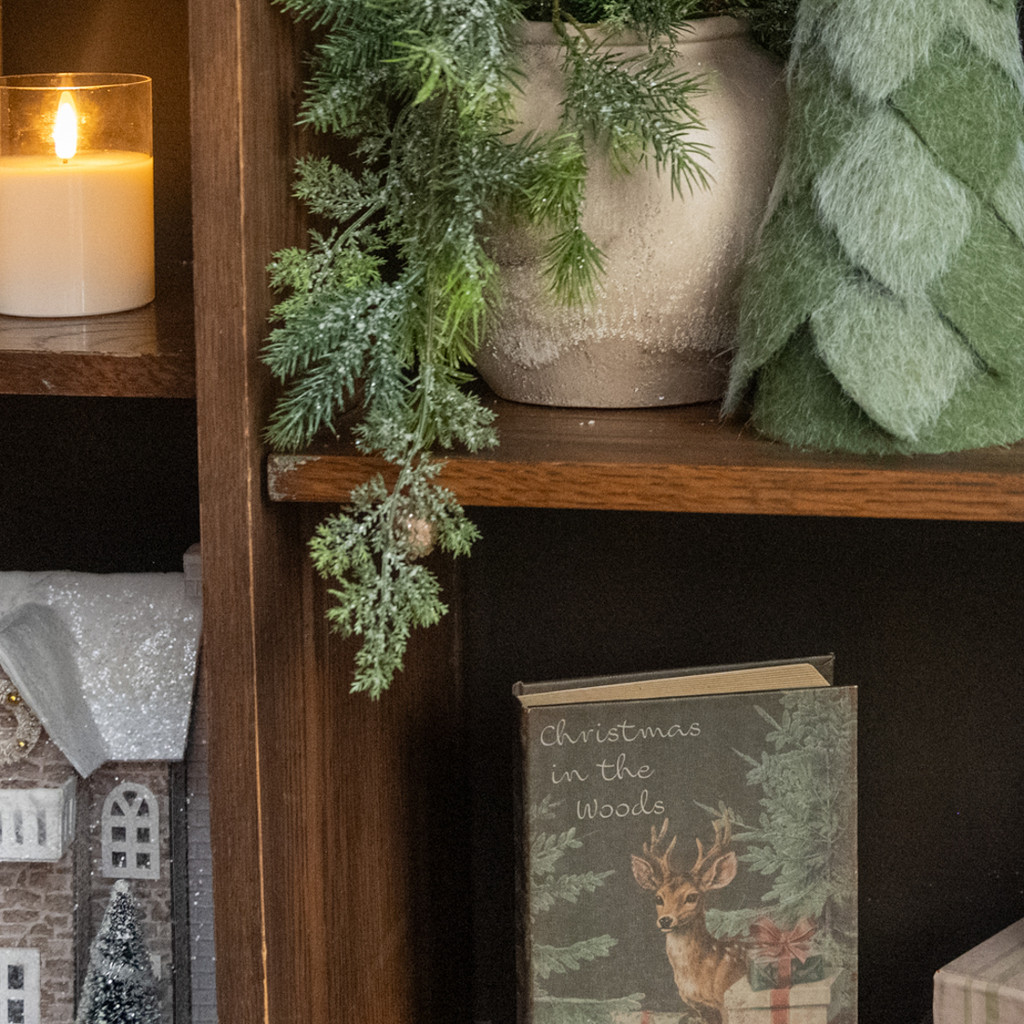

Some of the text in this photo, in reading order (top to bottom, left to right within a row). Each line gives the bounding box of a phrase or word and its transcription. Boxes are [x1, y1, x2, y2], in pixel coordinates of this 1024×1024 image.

[540, 719, 701, 747] Christmas
[551, 753, 655, 784] in the
[576, 789, 666, 820] Woods
